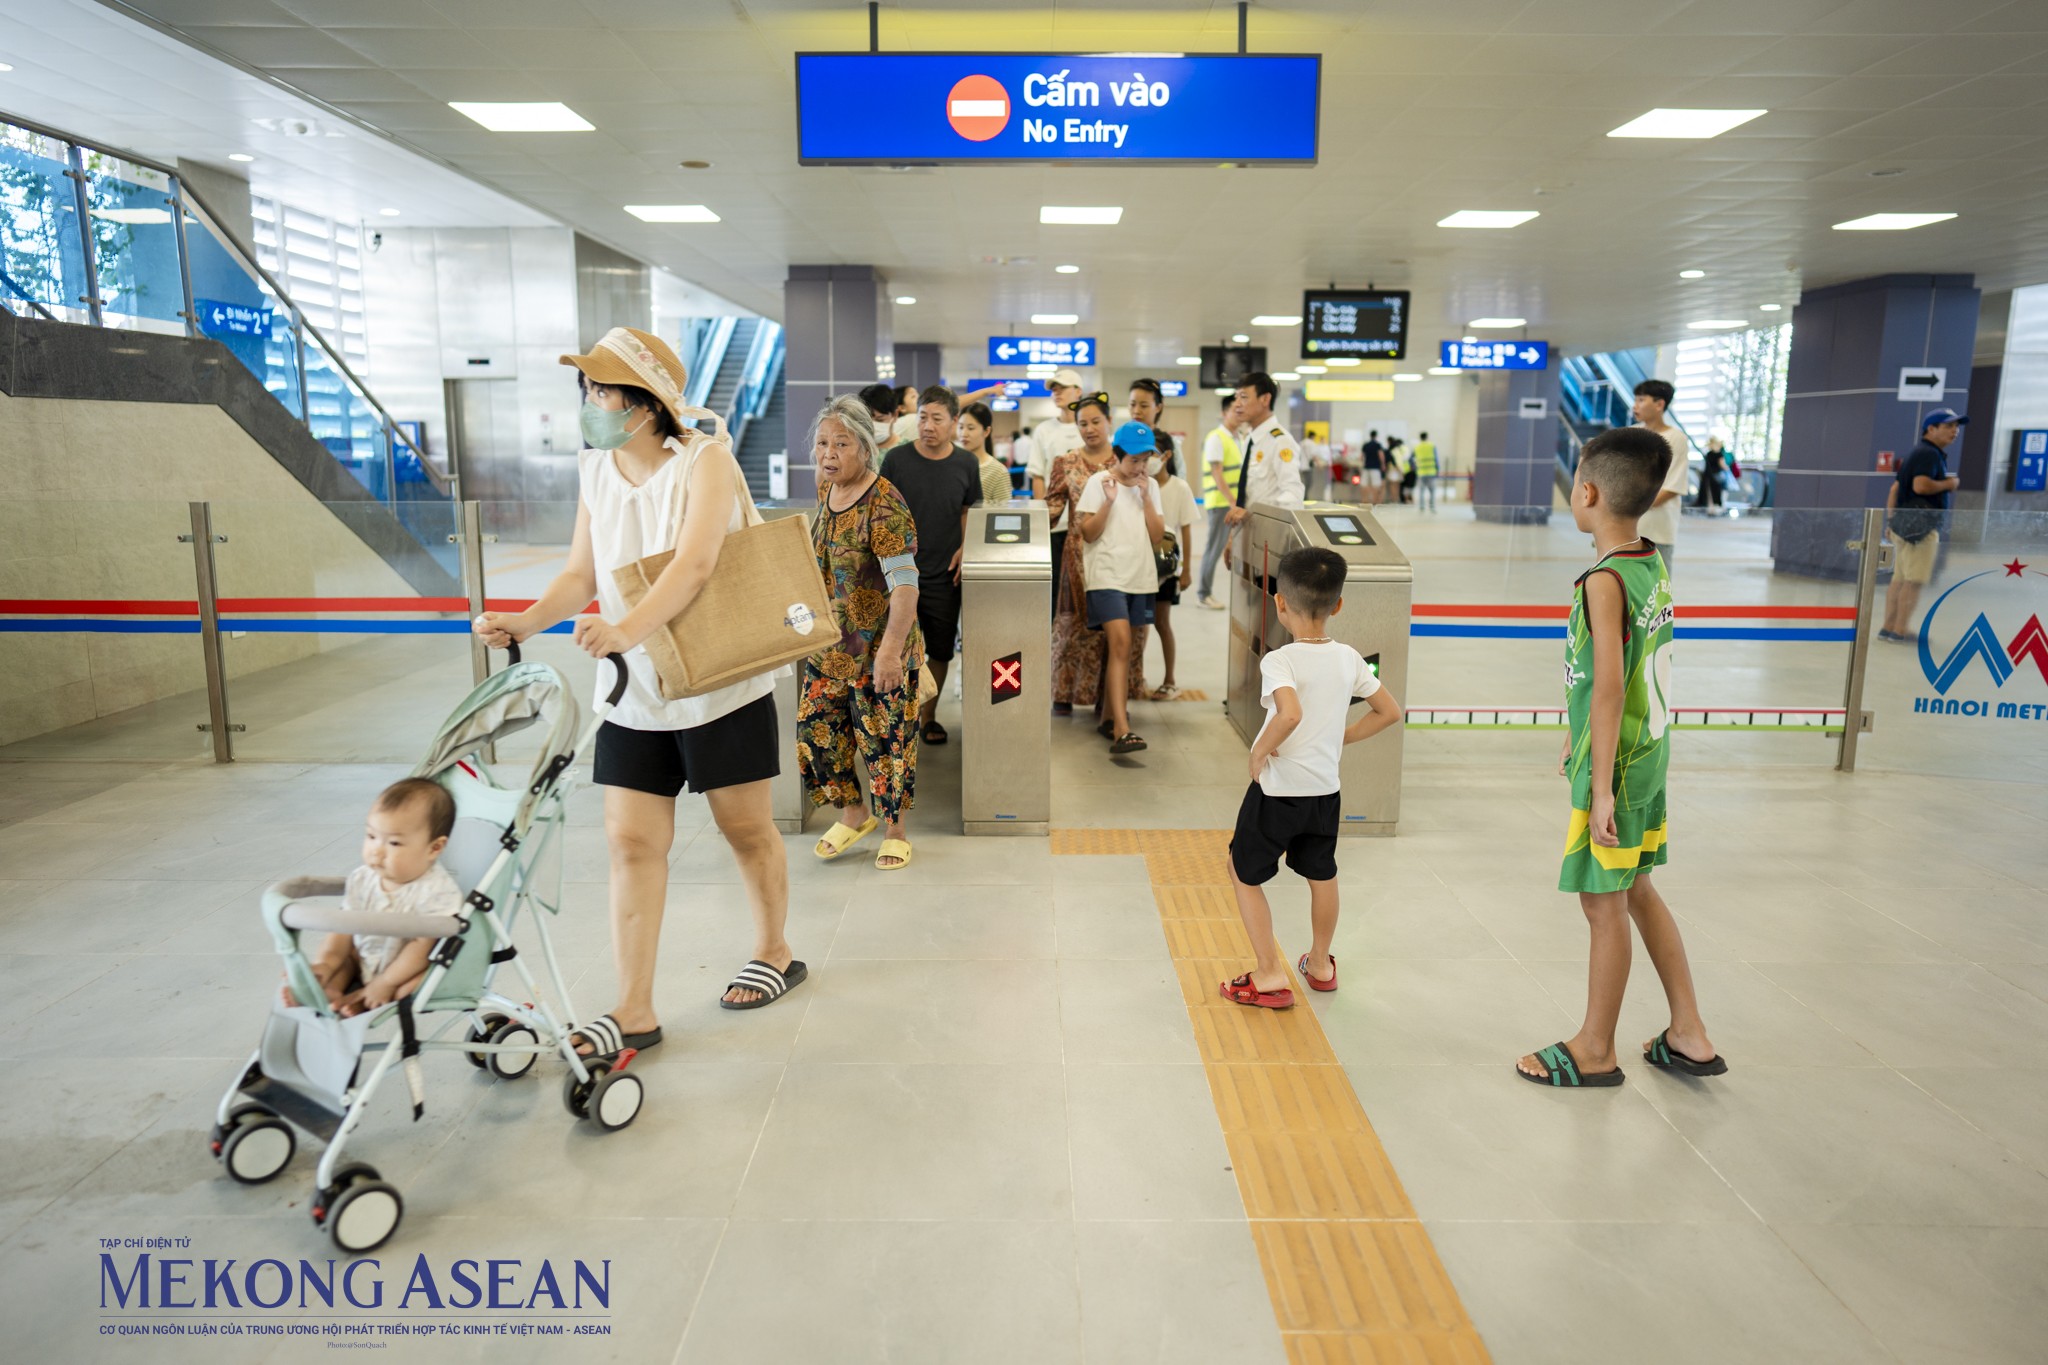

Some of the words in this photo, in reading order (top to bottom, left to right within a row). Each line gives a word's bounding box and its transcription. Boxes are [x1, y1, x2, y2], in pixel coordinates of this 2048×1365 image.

[1023, 69, 1099, 107] Cấm
[1109, 73, 1170, 107] vào
[1023, 118, 1058, 143] No
[1064, 118, 1129, 148] Entry
[1074, 341, 1089, 364] 2
[1448, 344, 1458, 366] 1
[1914, 698, 1988, 717] HANOI
[1997, 702, 2048, 721] MET
